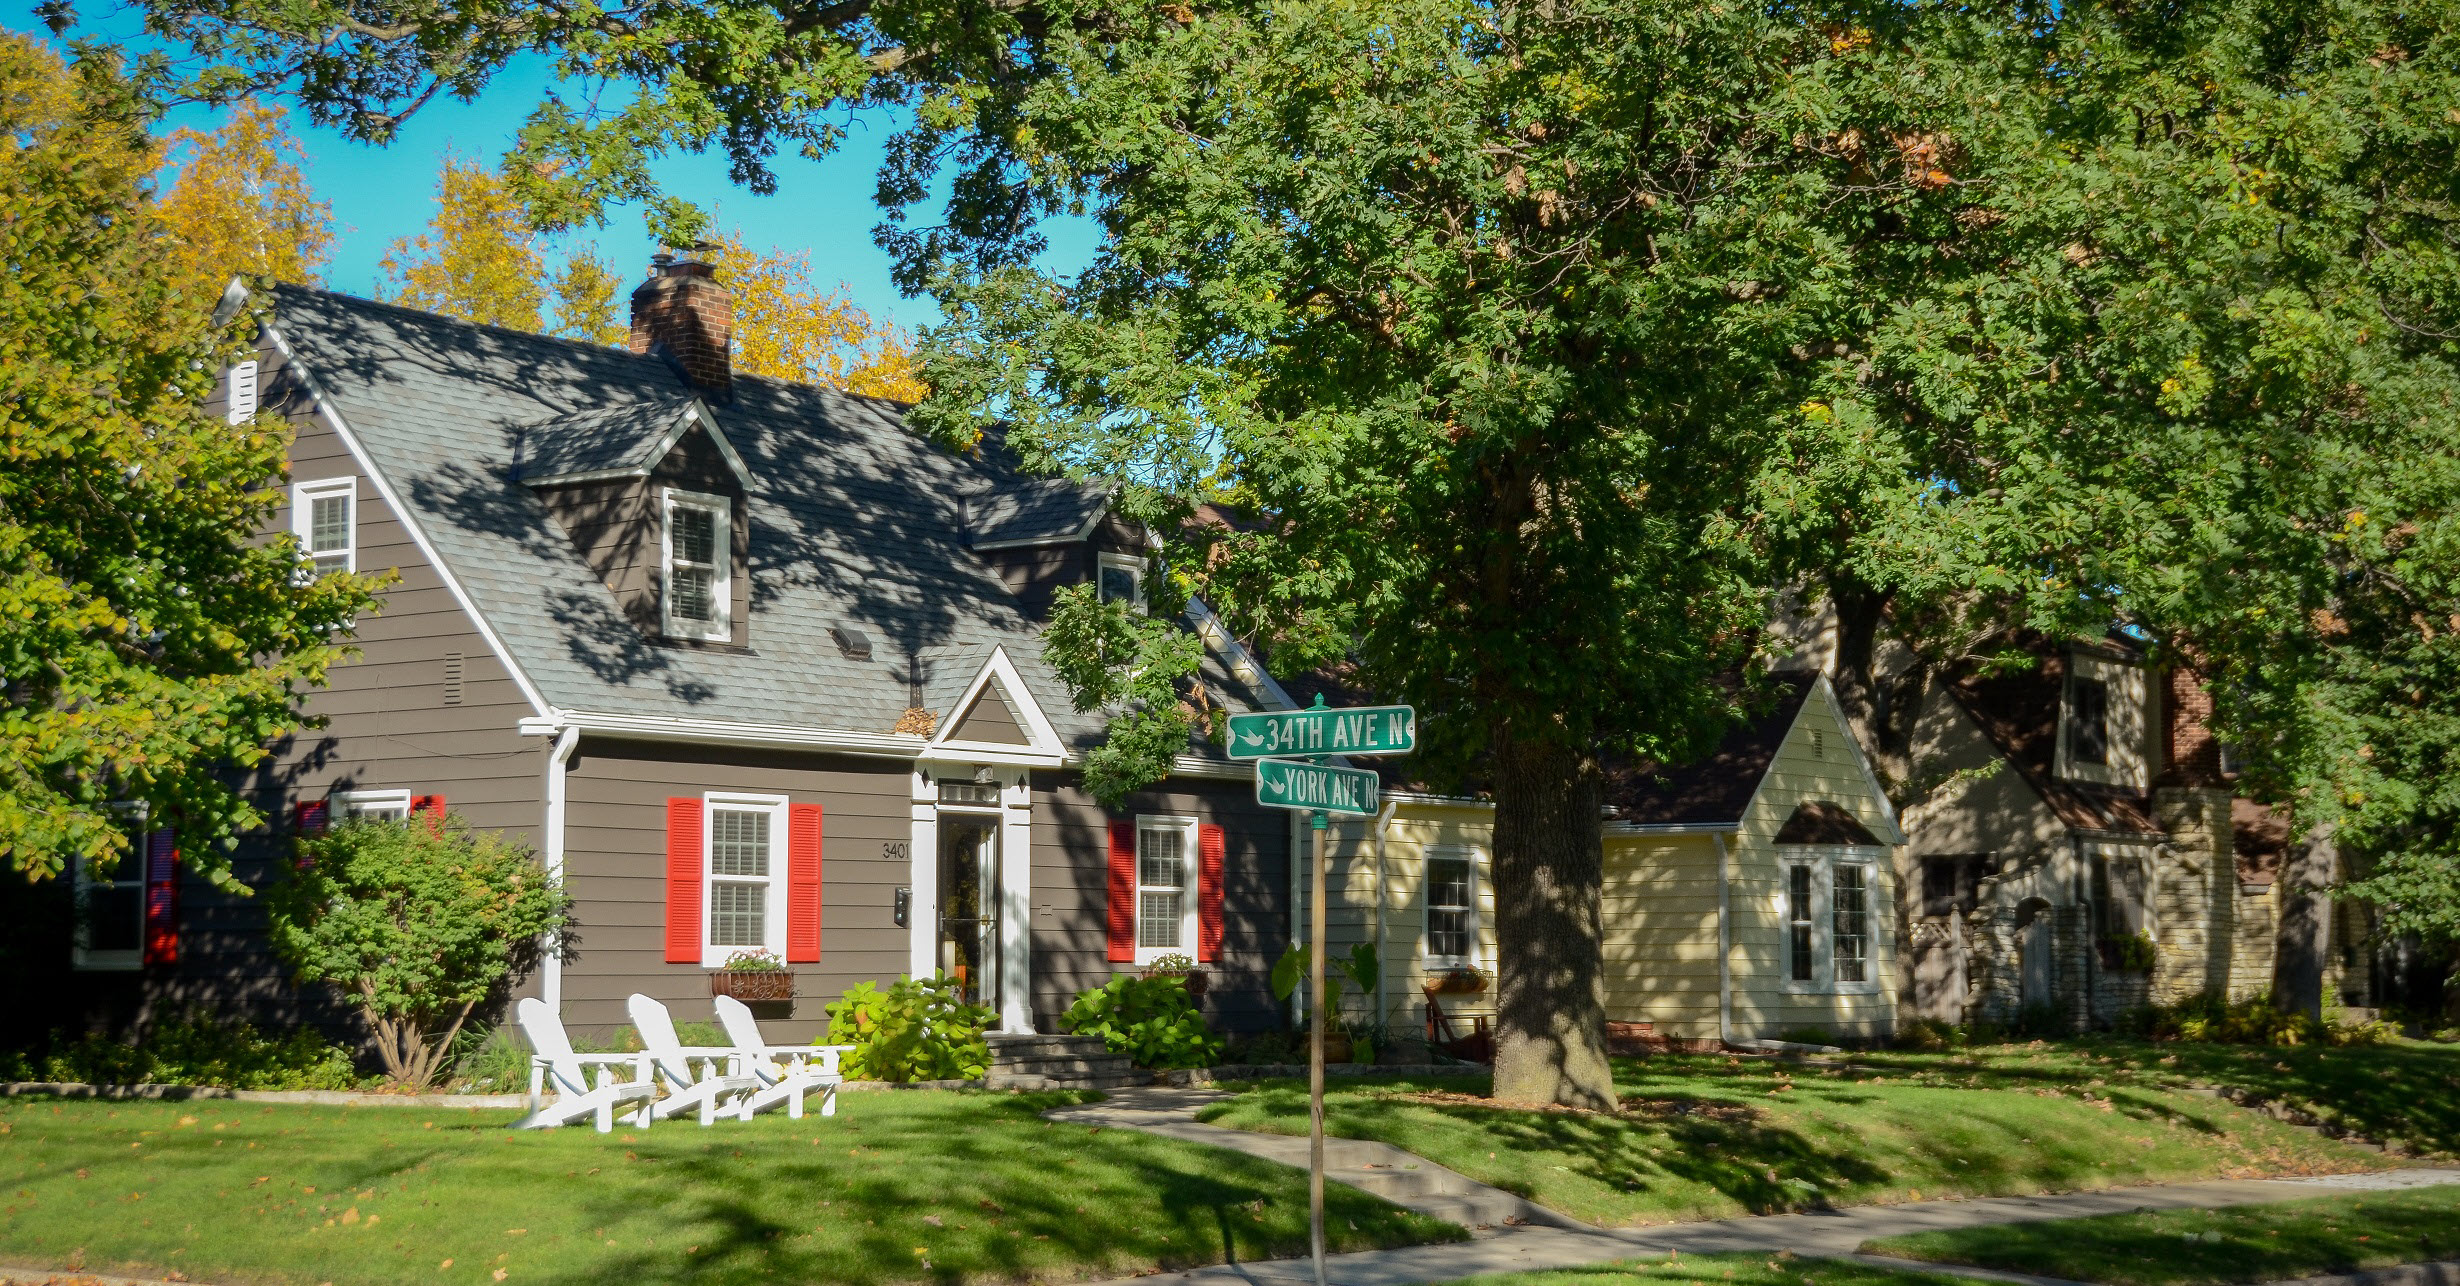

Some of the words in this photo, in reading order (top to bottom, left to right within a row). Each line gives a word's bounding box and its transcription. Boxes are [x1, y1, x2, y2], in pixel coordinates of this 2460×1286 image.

[1266, 716, 1322, 750] 34TH
[1333, 714, 1378, 748] AVE
[1389, 713, 1403, 745] N
[1285, 768, 1328, 804] YORK
[1332, 774, 1360, 807] AVE
[1365, 778, 1374, 809] N
[883, 842, 909, 859] 3401
